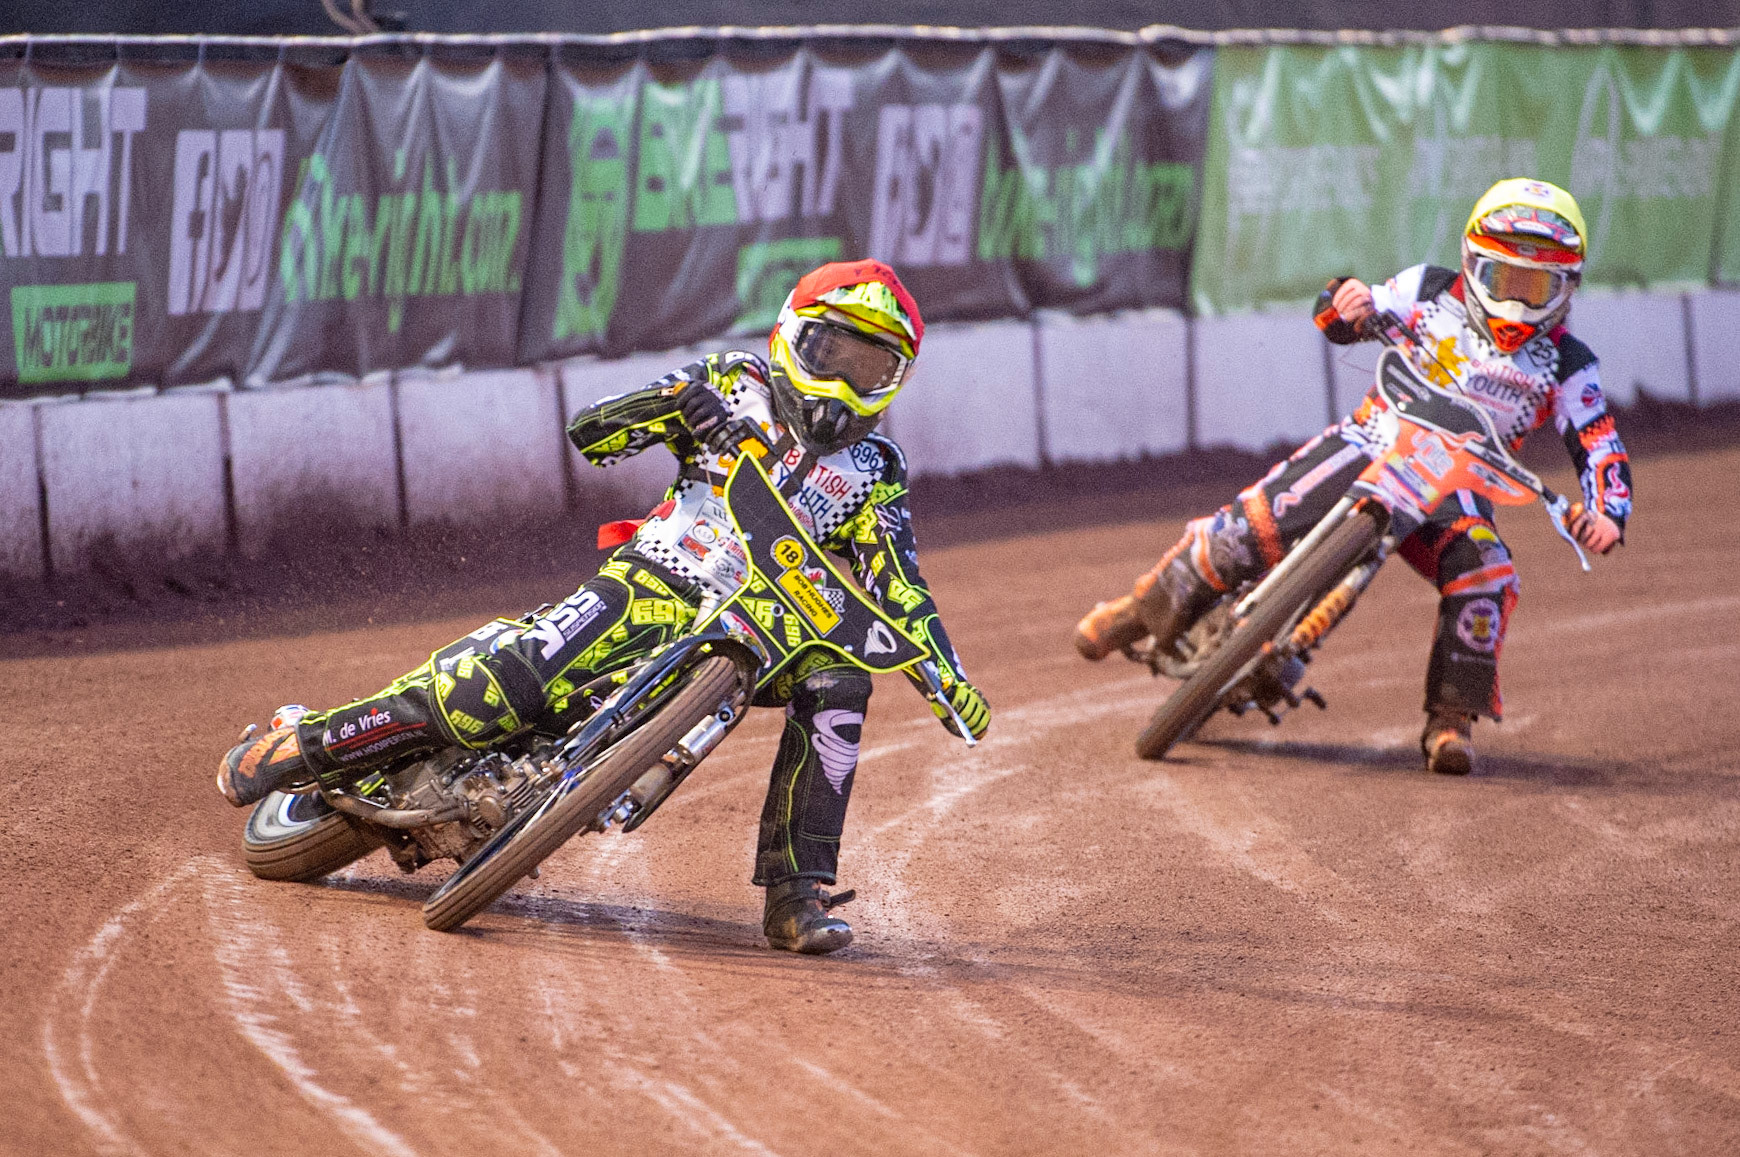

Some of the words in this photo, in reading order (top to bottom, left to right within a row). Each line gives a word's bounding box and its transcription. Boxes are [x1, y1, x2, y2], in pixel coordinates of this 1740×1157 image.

[1465, 368, 1524, 404] YOUTH
[851, 442, 879, 469] 696
[780, 543, 800, 564] 18
[793, 574, 808, 591] BOB
[806, 588, 833, 619] HUGHES
[793, 590, 818, 617] RACING
[520, 586, 601, 661] YSS
[322, 729, 337, 747] M.
[340, 722, 356, 740] de
[358, 707, 391, 731] Vries
